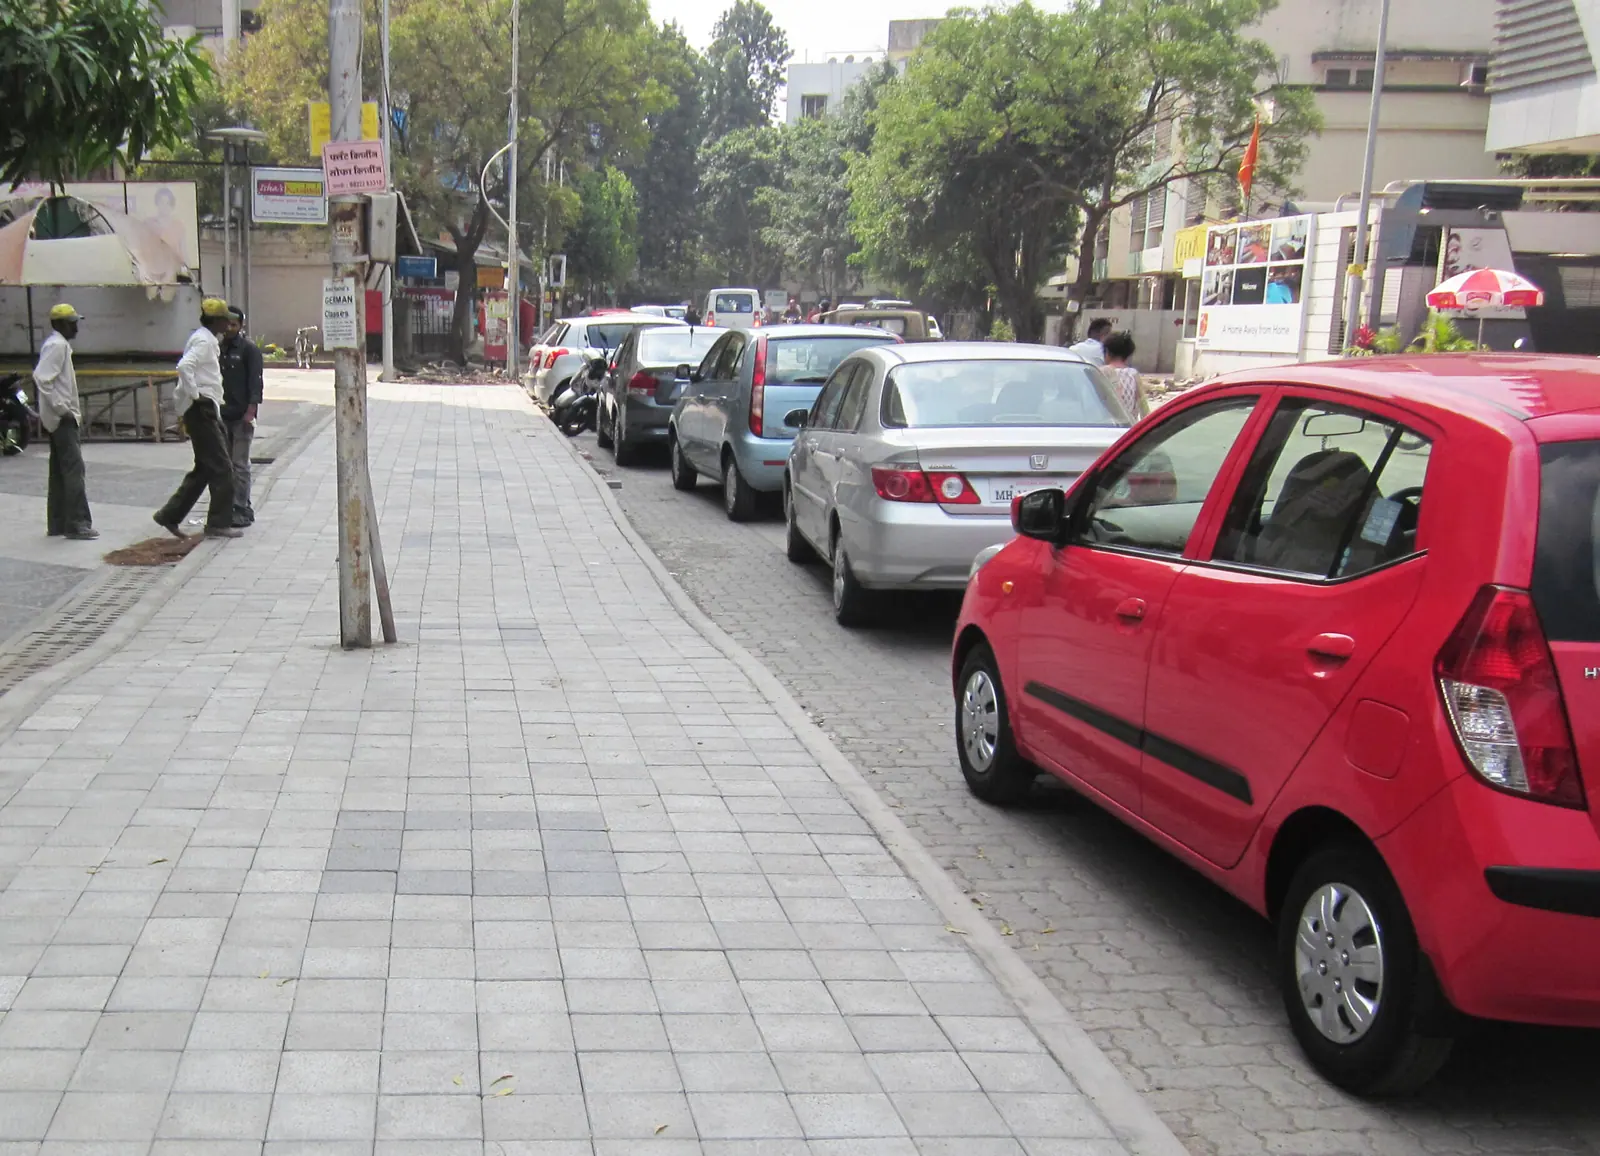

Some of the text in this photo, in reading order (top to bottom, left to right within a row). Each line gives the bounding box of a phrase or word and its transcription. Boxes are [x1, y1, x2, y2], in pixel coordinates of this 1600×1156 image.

[324, 295, 353, 305] GERMAN
[1222, 324, 1290, 336] A Home Away from Home
